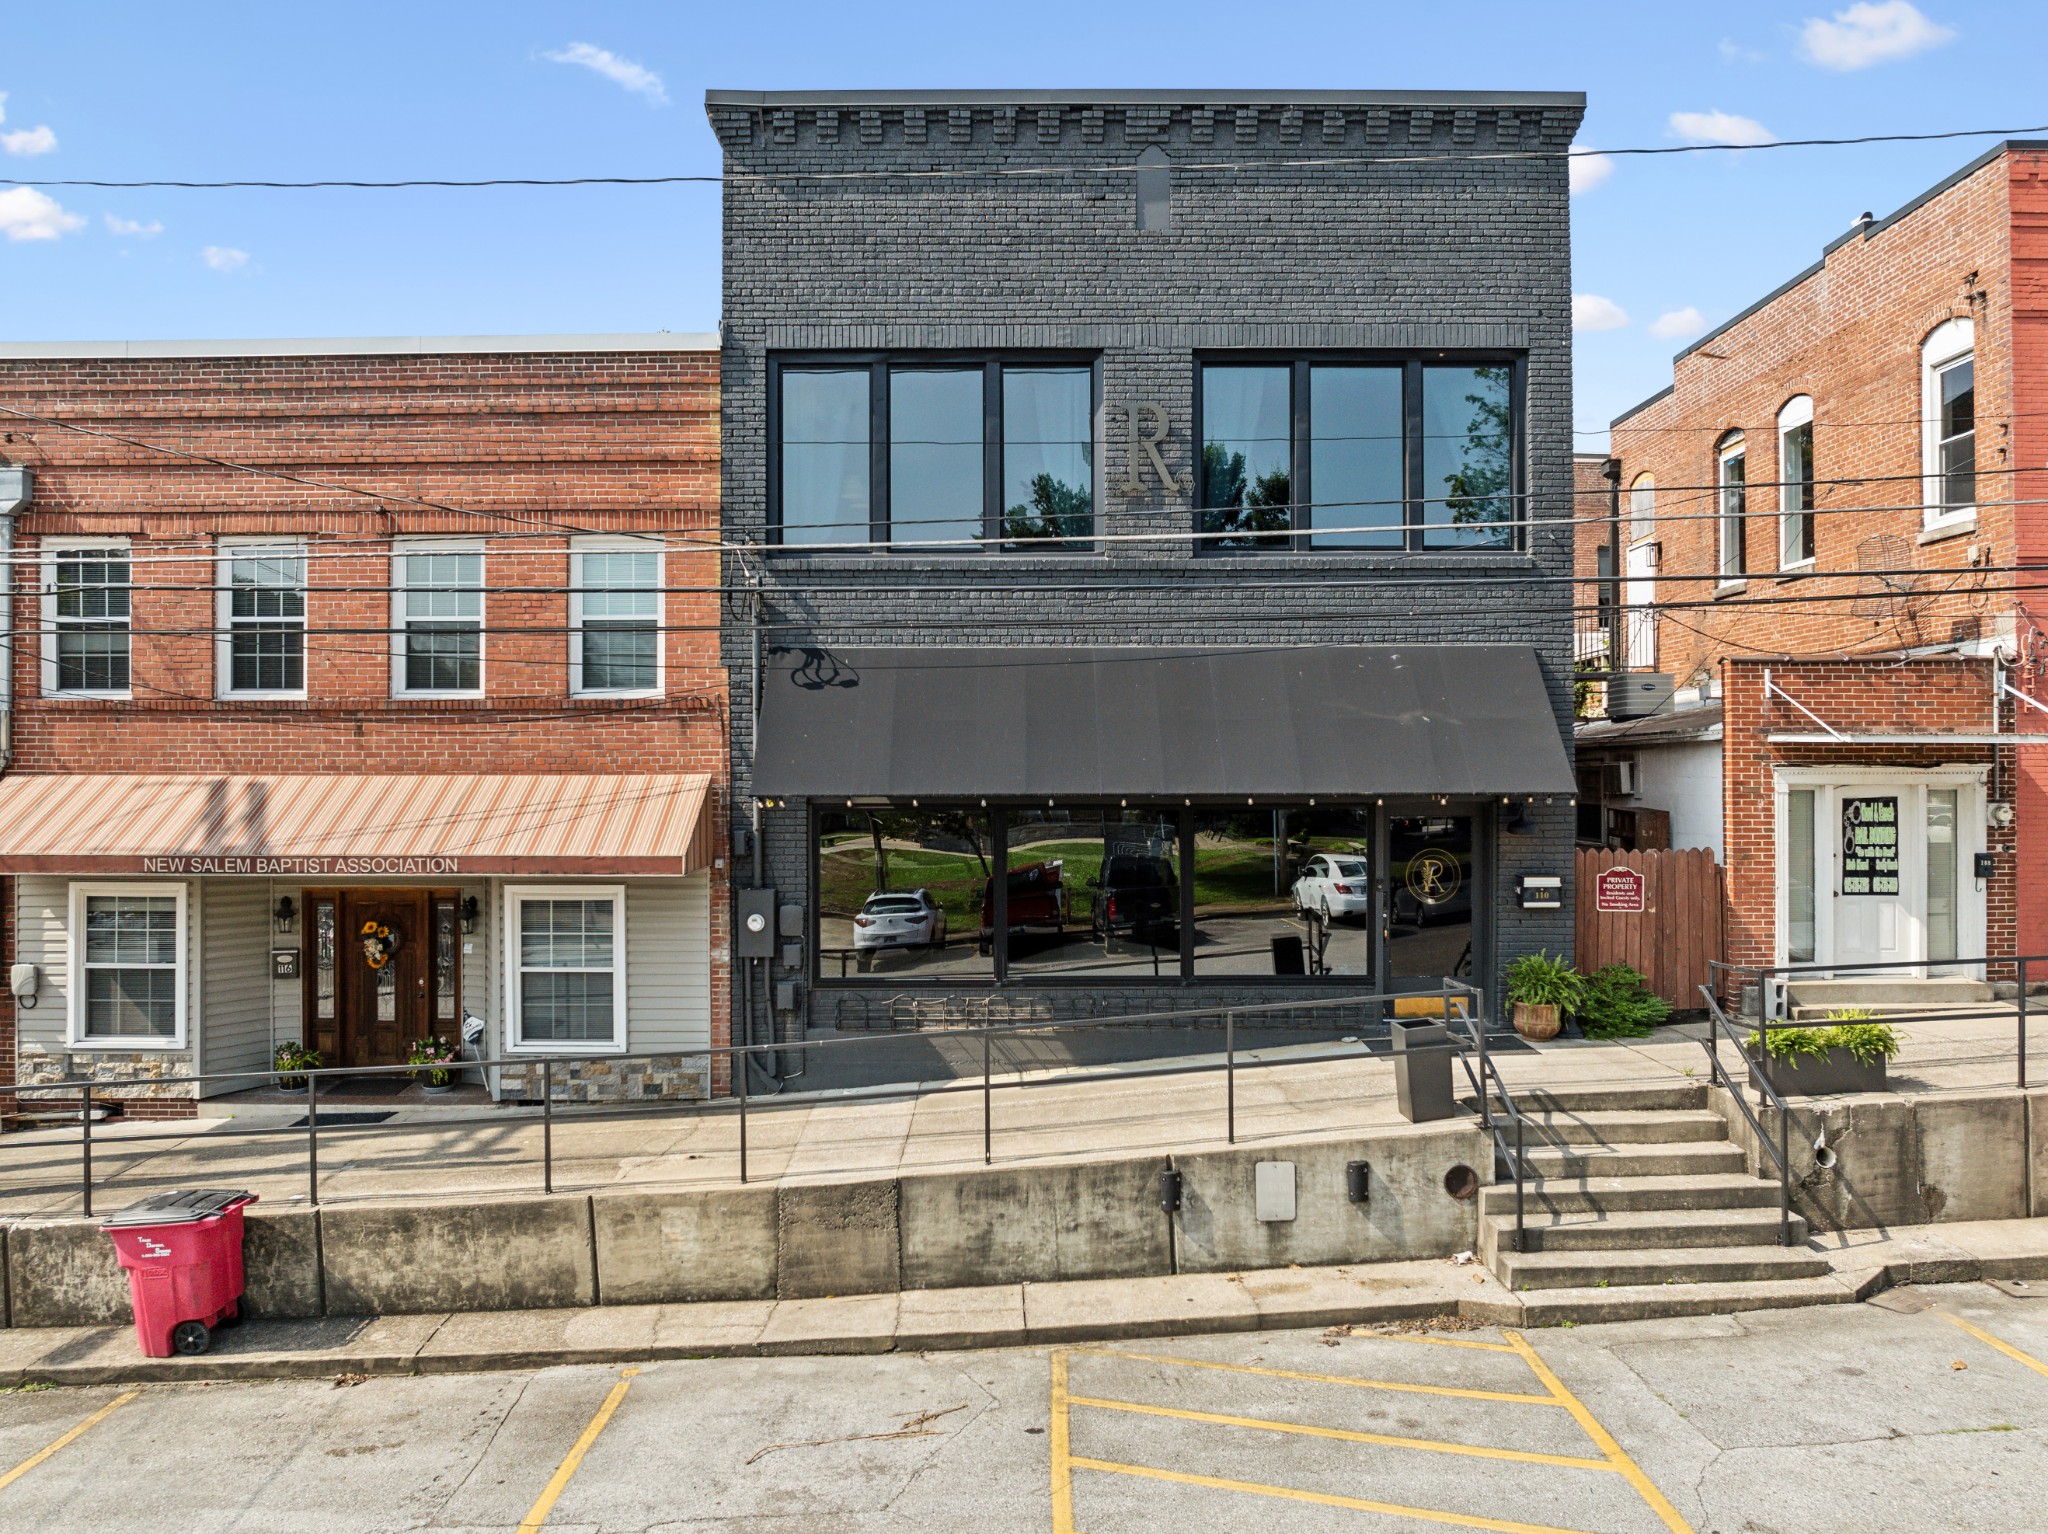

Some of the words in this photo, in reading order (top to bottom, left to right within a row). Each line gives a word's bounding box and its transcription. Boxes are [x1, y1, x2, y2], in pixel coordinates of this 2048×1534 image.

[1119, 400, 1181, 492] R
[143, 857, 186, 873] NEW
[190, 857, 251, 873] SALEM
[256, 857, 332, 873] BAPTIST
[334, 857, 458, 873] ASSOCIATION
[1422, 860, 1445, 893] R
[1535, 891, 1550, 899] 110
[277, 964, 293, 974] 116
